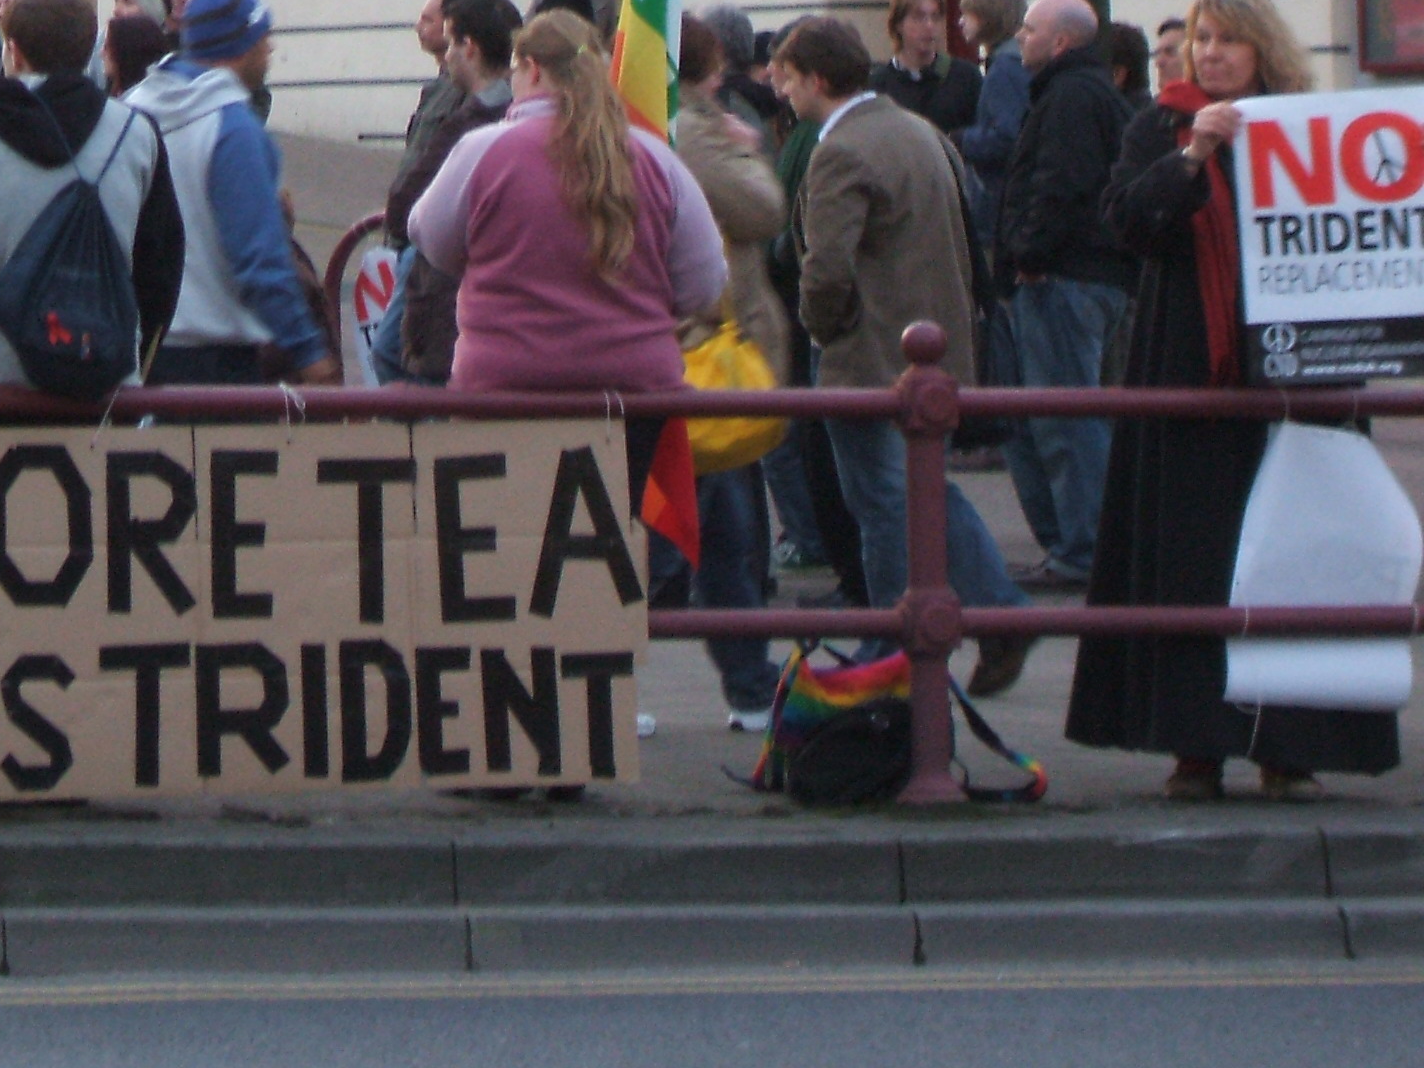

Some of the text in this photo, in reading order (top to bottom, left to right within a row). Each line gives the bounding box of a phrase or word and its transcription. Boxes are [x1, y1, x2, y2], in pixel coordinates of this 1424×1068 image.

[1247, 110, 1424, 208] NO
[316, 445, 644, 623] TEA
[98, 638, 634, 787] TRIDENT
